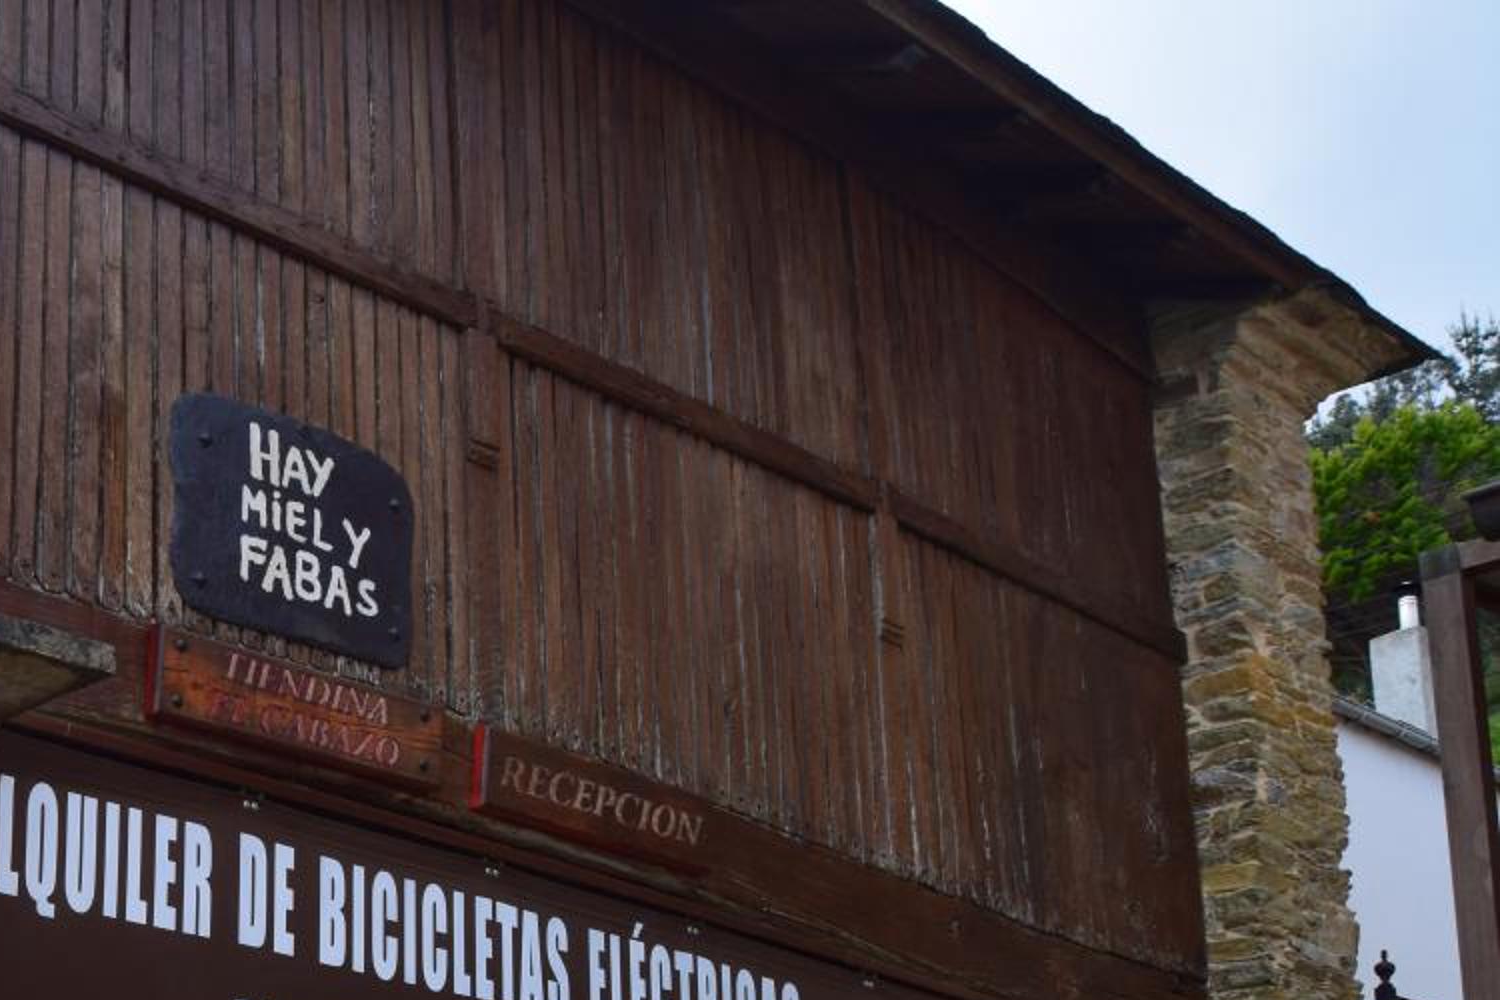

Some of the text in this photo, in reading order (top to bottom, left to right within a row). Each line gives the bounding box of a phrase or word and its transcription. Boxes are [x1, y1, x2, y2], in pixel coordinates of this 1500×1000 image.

[249, 421, 335, 498] HAY
[239, 533, 379, 617] FABAS
[342, 518, 371, 569] Y
[226, 652, 388, 725] TIENDINA
[500, 756, 705, 847] RECEPCION
[237, 831, 295, 957] DE
